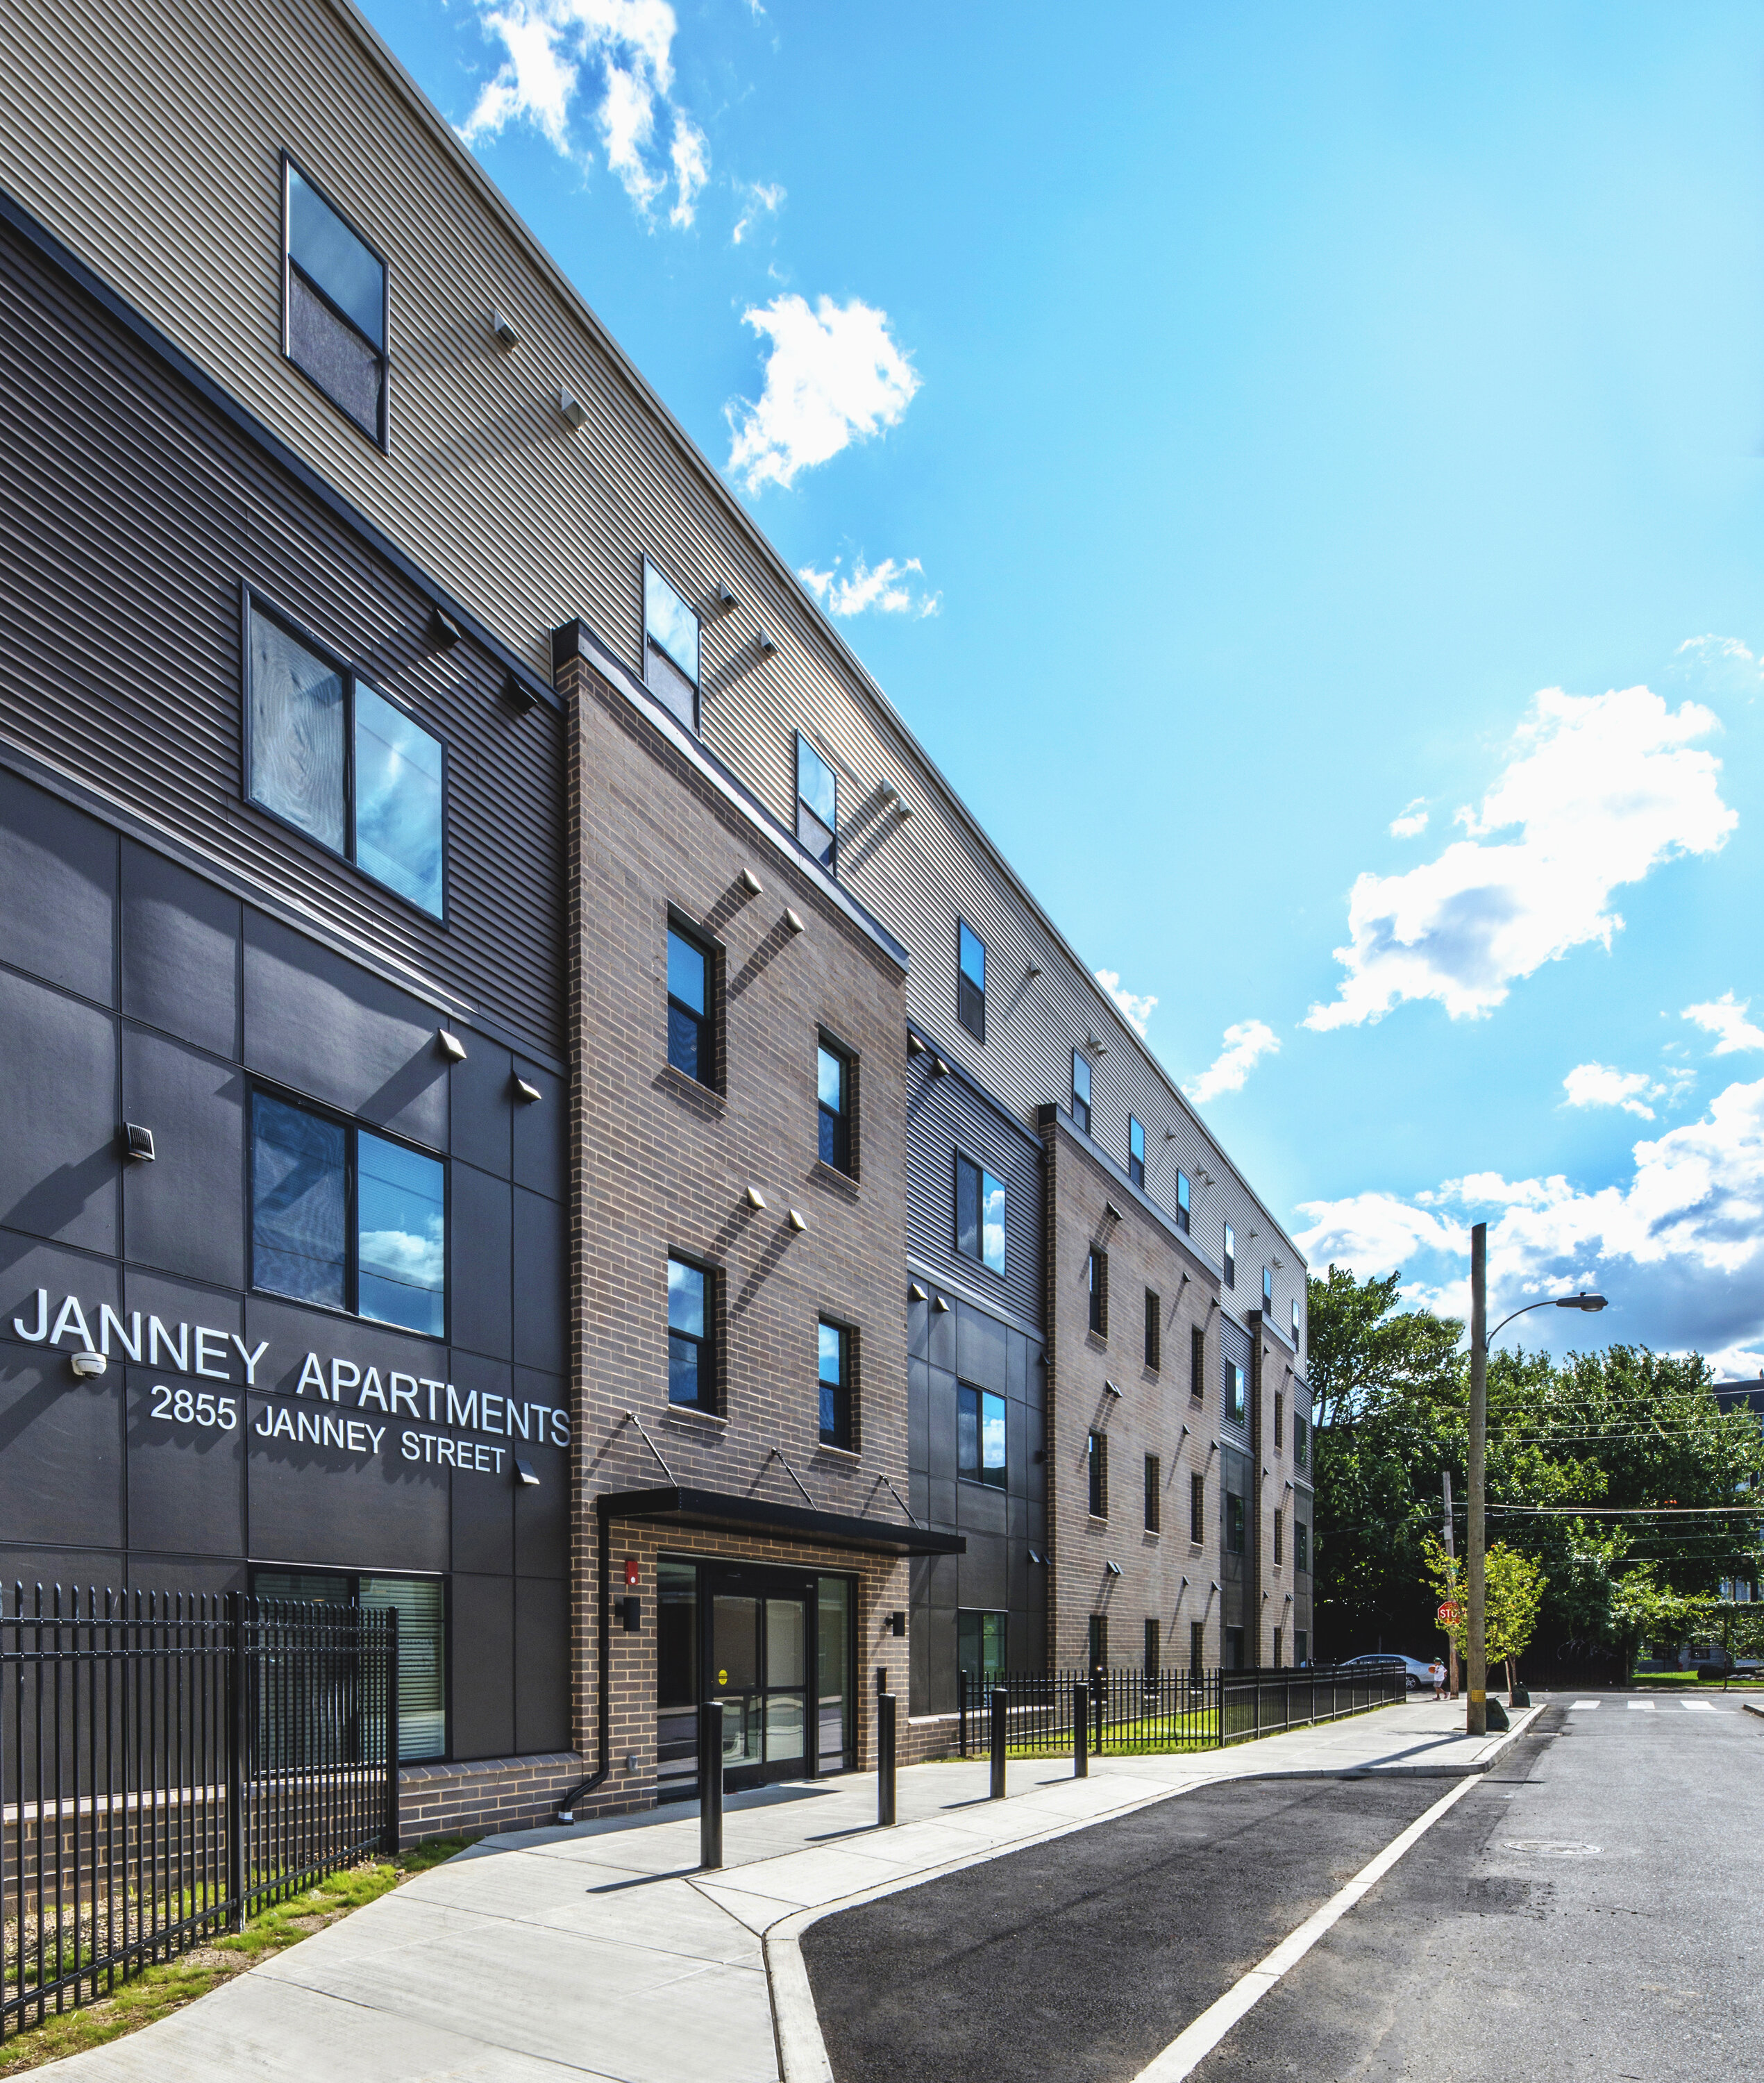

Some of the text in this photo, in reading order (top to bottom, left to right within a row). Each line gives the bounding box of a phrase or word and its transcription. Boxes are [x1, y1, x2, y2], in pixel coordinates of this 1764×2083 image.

[14, 1288, 571, 1447] JANNEY APARTMENTS
[151, 1385, 506, 1473] 2855 JANNEY STREET
[1440, 1609, 1463, 1618] STO
